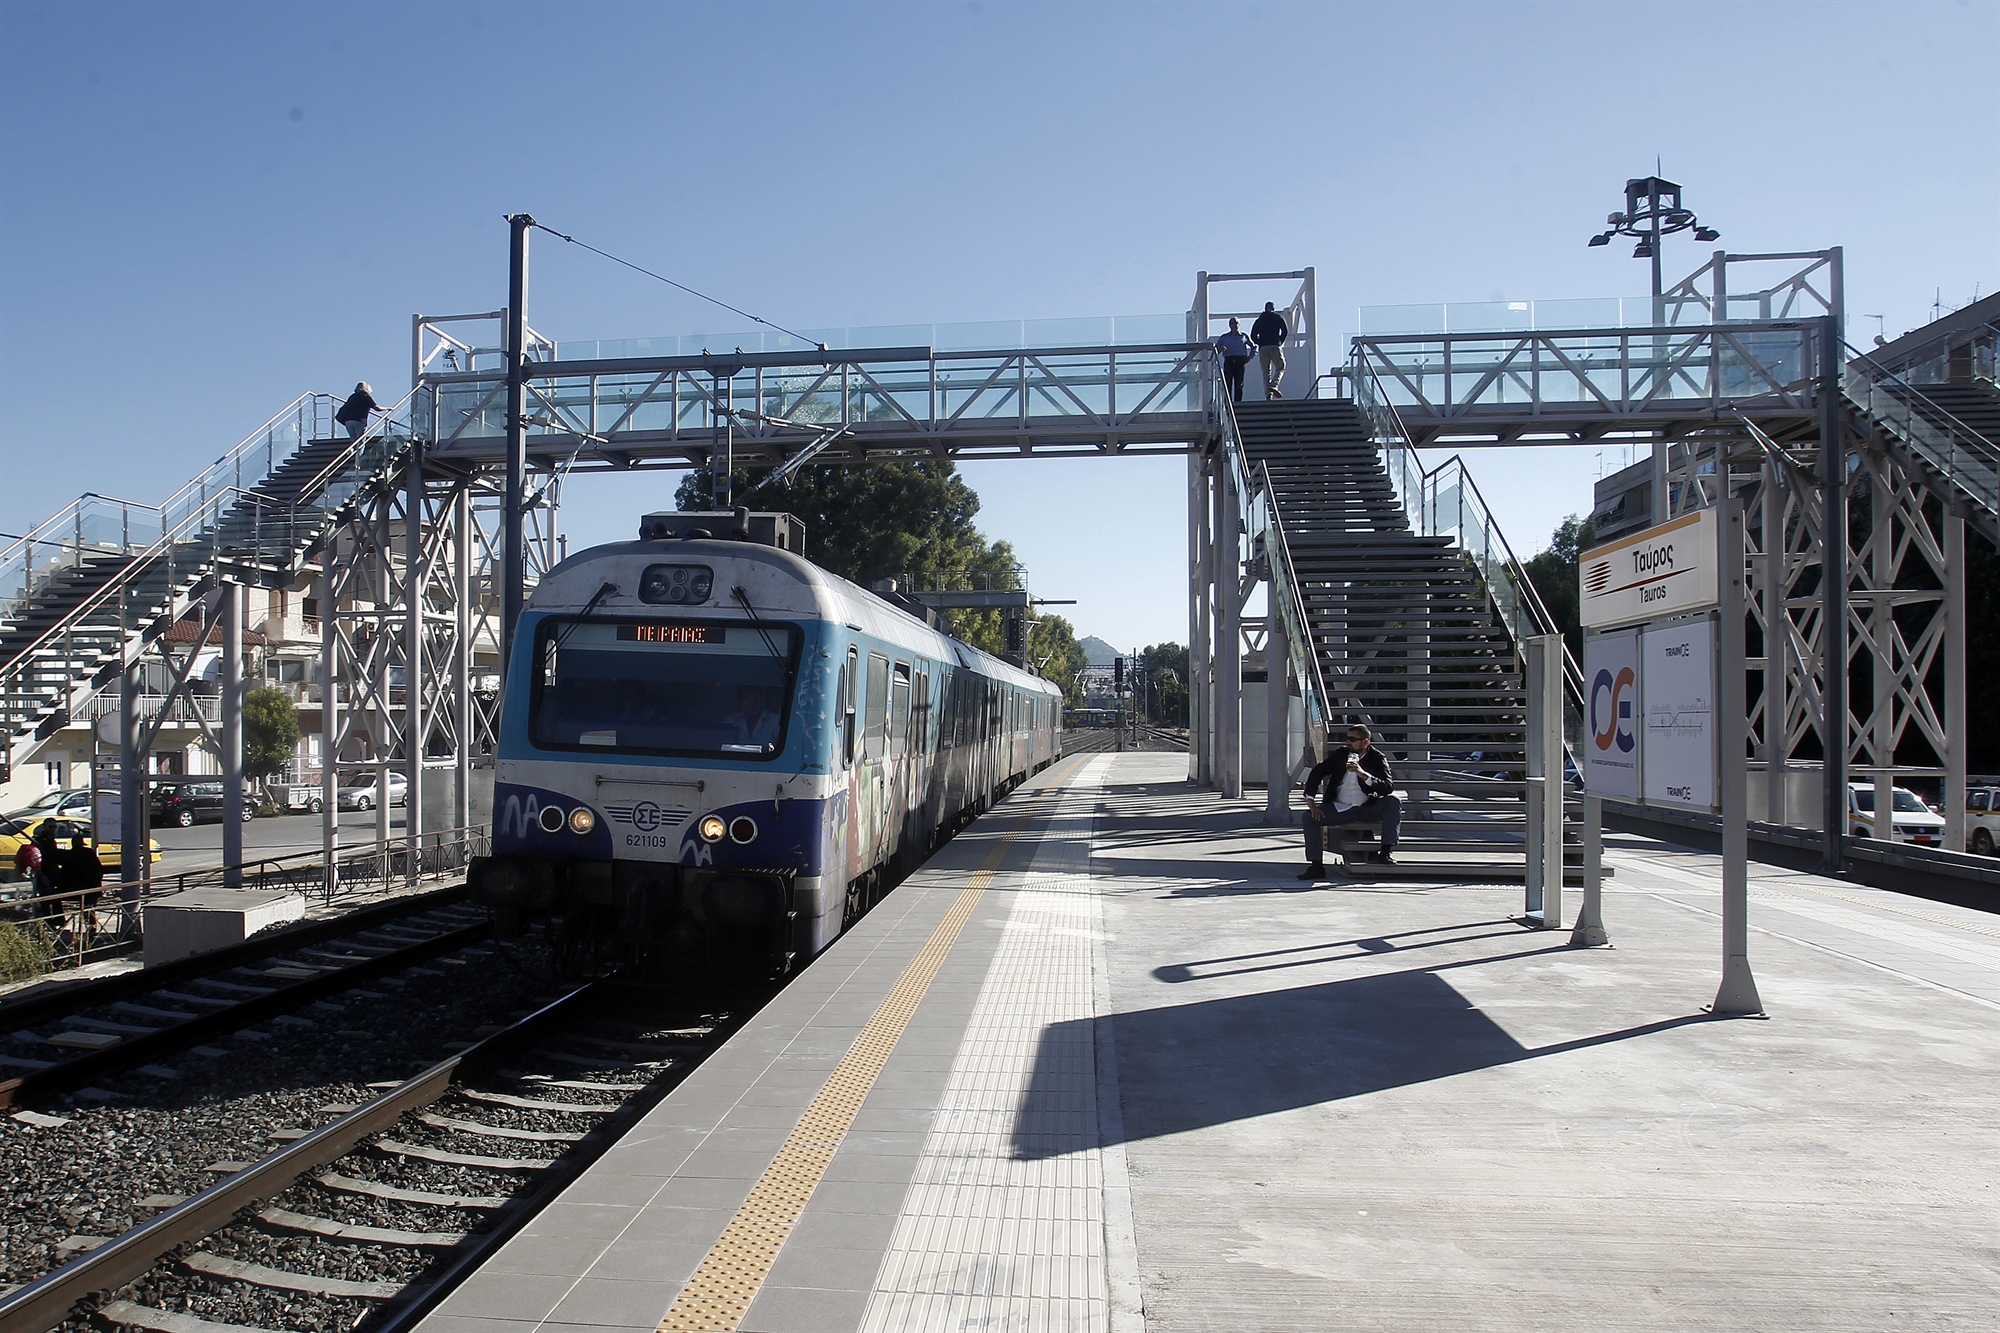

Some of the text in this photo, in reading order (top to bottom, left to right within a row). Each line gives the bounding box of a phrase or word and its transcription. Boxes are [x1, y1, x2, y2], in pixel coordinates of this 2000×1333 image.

[1633, 544, 1673, 574] Ταύρος
[1639, 585, 1666, 603] Tauros
[626, 834, 667, 848] 621109
